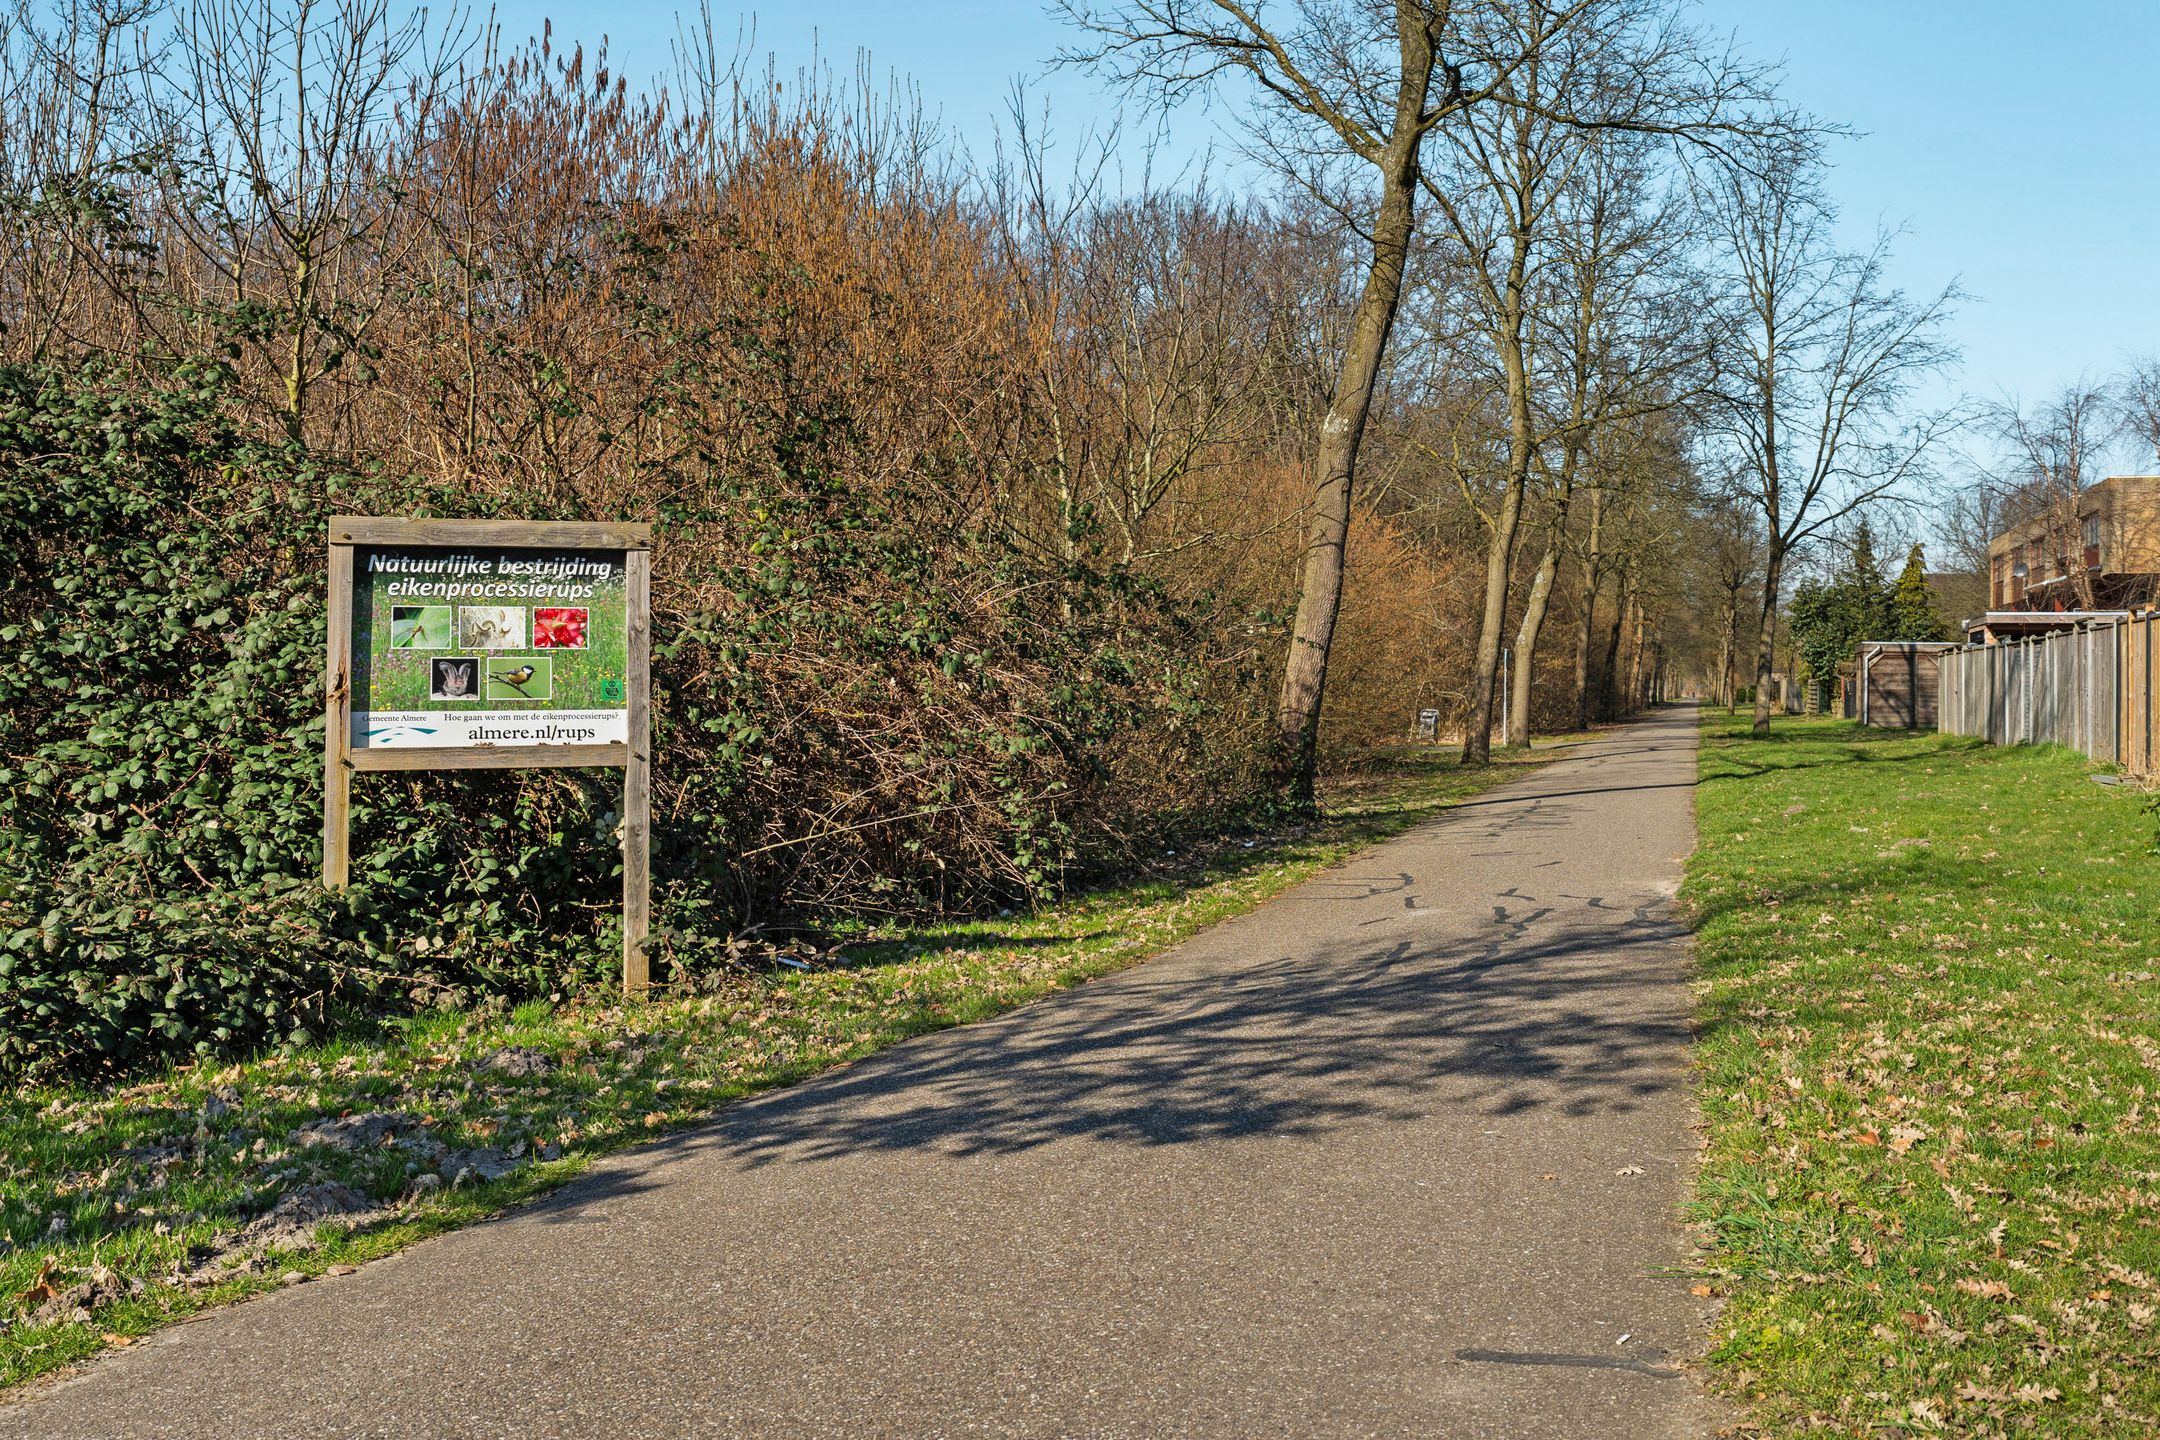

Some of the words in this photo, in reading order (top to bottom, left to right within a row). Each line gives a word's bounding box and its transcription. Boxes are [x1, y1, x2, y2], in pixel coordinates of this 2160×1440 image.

[368, 554, 492, 578] Natuurlijke
[498, 555, 612, 580] bestrijding
[387, 577, 594, 601] eikenprocessierups
[361, 714, 400, 723] Gemeente
[400, 714, 427, 723] Almere
[444, 713, 462, 722] Hoe
[463, 715, 483, 723] gaan
[530, 713, 541, 721] de
[542, 711, 620, 722] eikenprocessierups?
[468, 725, 596, 741] almere.nl/rups
